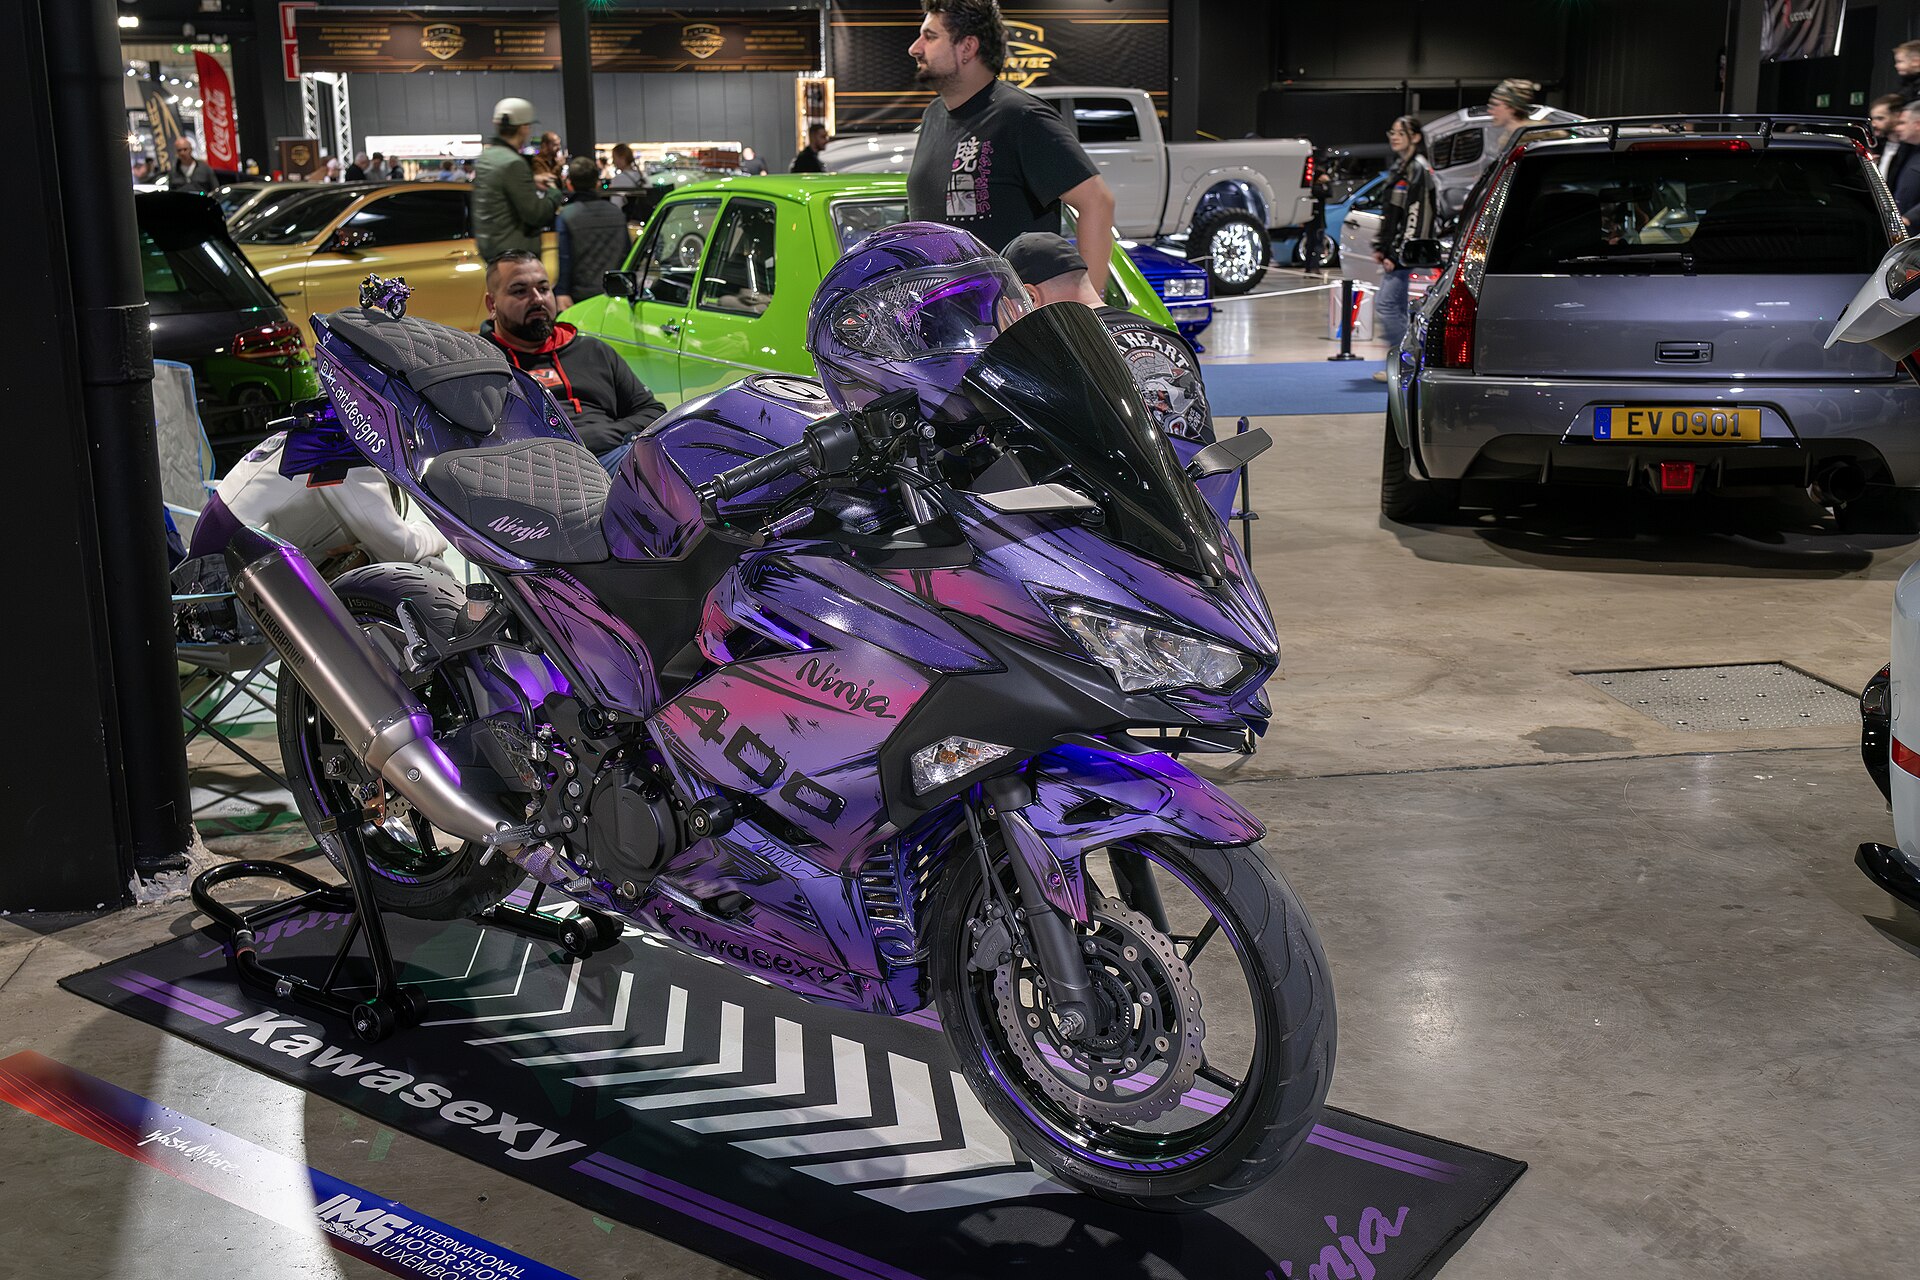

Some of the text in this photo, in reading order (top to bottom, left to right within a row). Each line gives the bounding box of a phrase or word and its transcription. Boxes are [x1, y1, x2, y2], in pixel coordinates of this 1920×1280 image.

[205, 87, 232, 161] Coca-Cola
[1403, 201, 1420, 242] NDA
[1121, 331, 1189, 369] HEART
[1600, 425, 1607, 434] L
[1627, 411, 1742, 437] EV 0901
[487, 515, 551, 543] Ninja
[796, 657, 896, 719] Ninja
[665, 696, 848, 829] 400
[654, 906, 842, 985] Kawasexy
[224, 1010, 587, 1161] Kawasexy
[313, 1193, 413, 1247] IMS
[1265, 1206, 1410, 1280] nja
[372, 1242, 468, 1280] LUXEMBO
[390, 1233, 460, 1266] MOTOR
[406, 1224, 526, 1279] INTERNATIONAL
